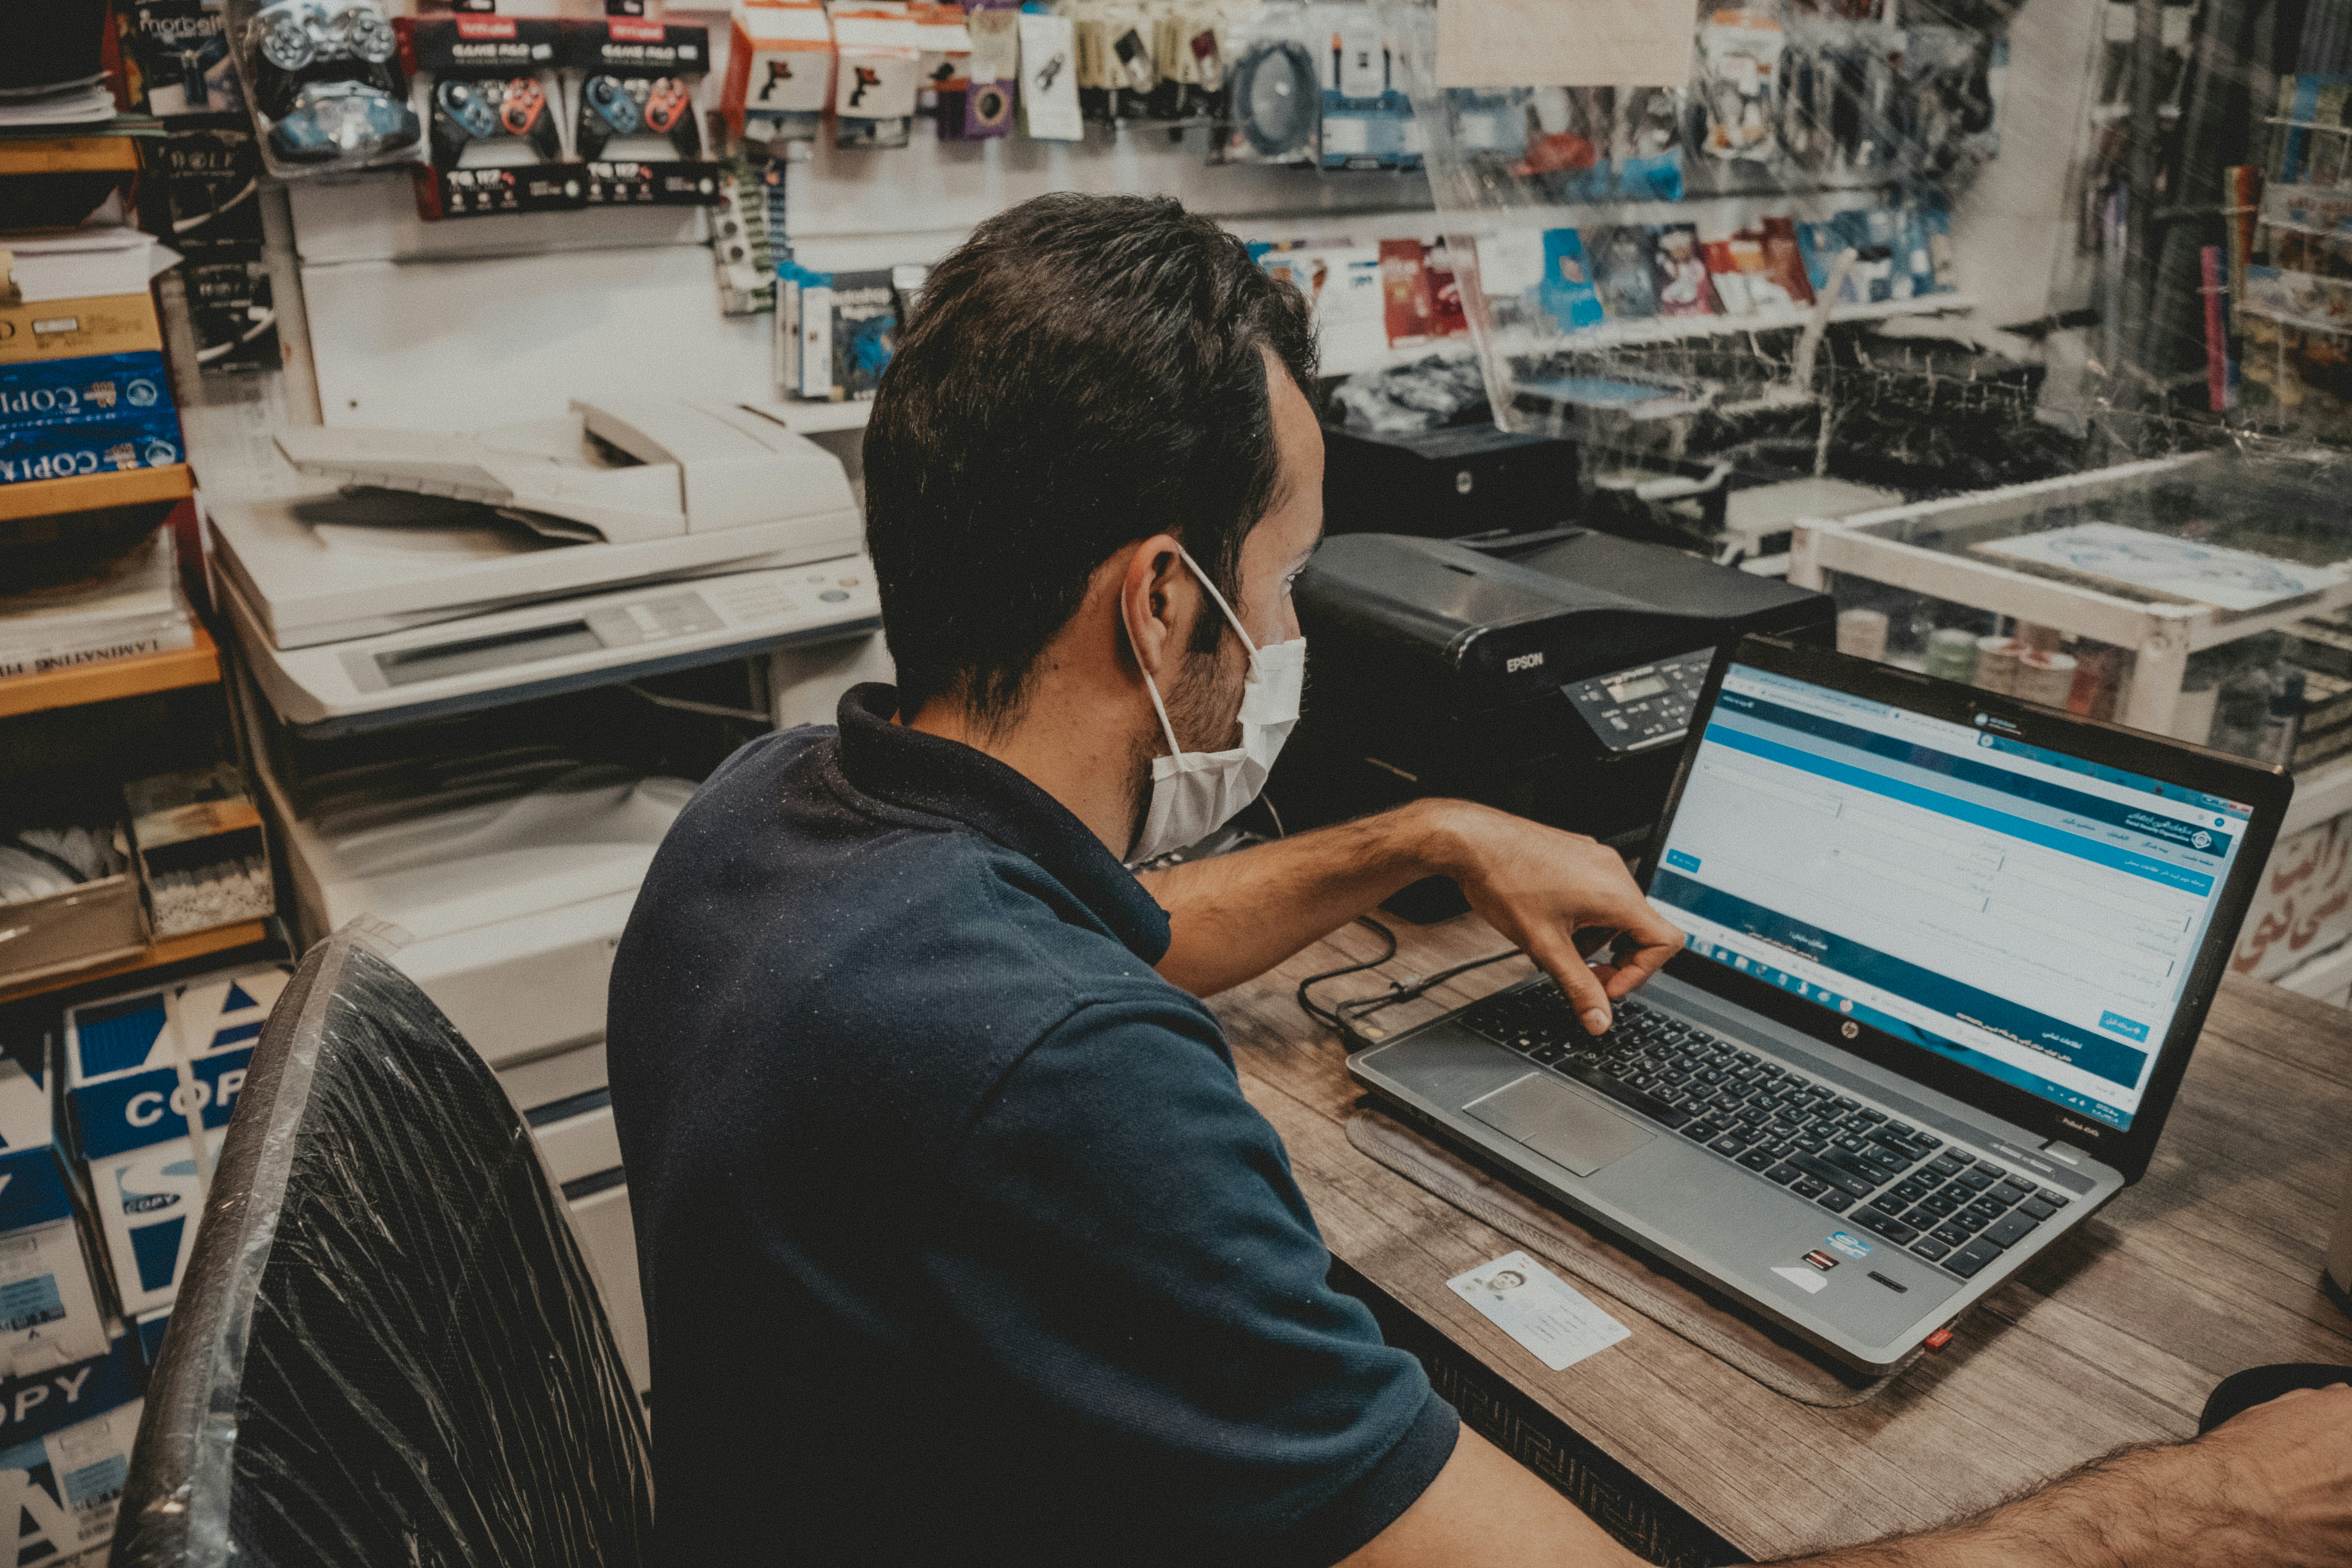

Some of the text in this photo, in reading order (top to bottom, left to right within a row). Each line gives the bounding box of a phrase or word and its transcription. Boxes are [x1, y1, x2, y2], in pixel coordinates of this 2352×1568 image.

[453, 43, 498, 57] GAME
[602, 44, 645, 58] GAME
[35, 640, 158, 673] LAMINATING
[1507, 652, 1543, 673] EPSON
[1841, 1021, 1859, 1039] hp
[125, 1068, 248, 1128] COP
[0, 1366, 92, 1428] PY
